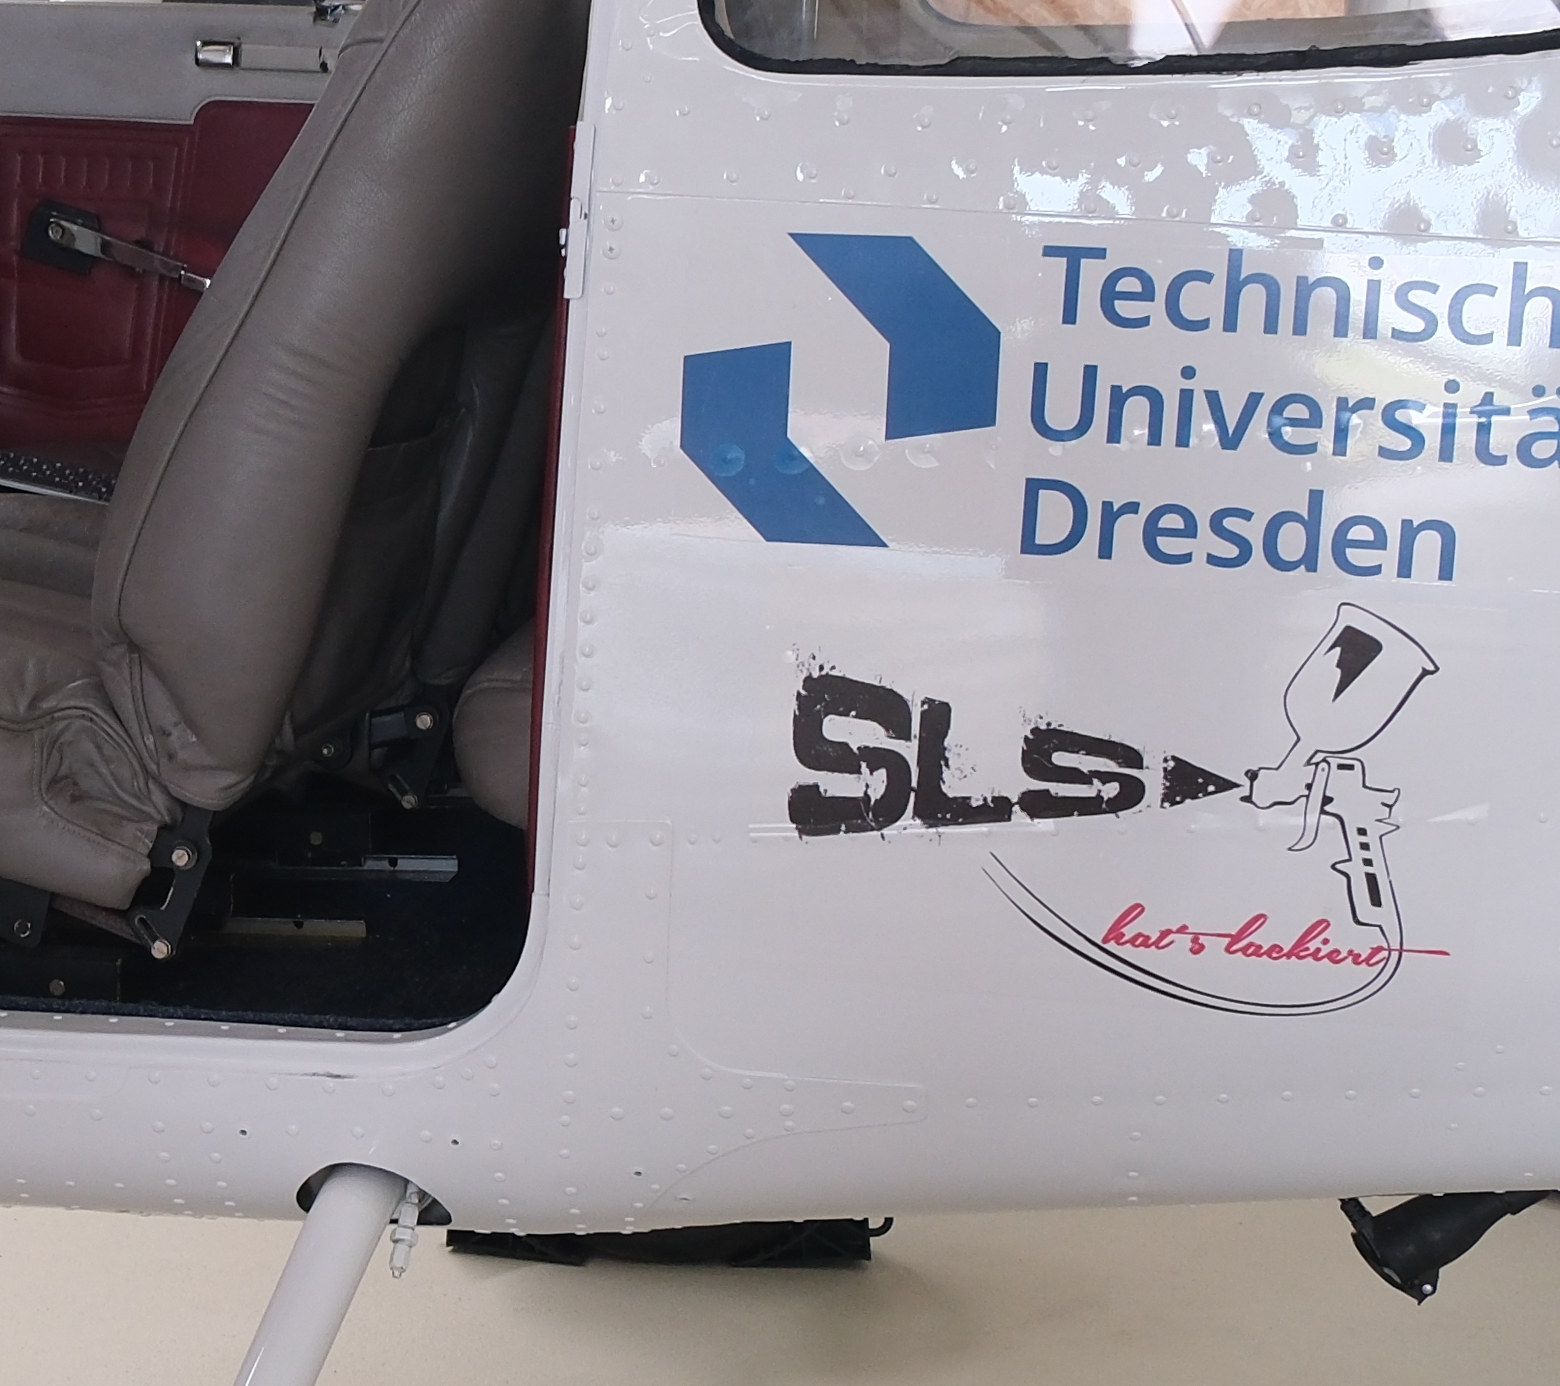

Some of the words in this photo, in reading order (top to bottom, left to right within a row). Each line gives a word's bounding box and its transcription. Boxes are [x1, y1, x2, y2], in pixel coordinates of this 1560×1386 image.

[1019, 476, 1458, 582] Dresden
[787, 668, 1146, 839] SLS
[1101, 902, 1206, 955] hat's
[1223, 913, 1450, 967] lackiert
